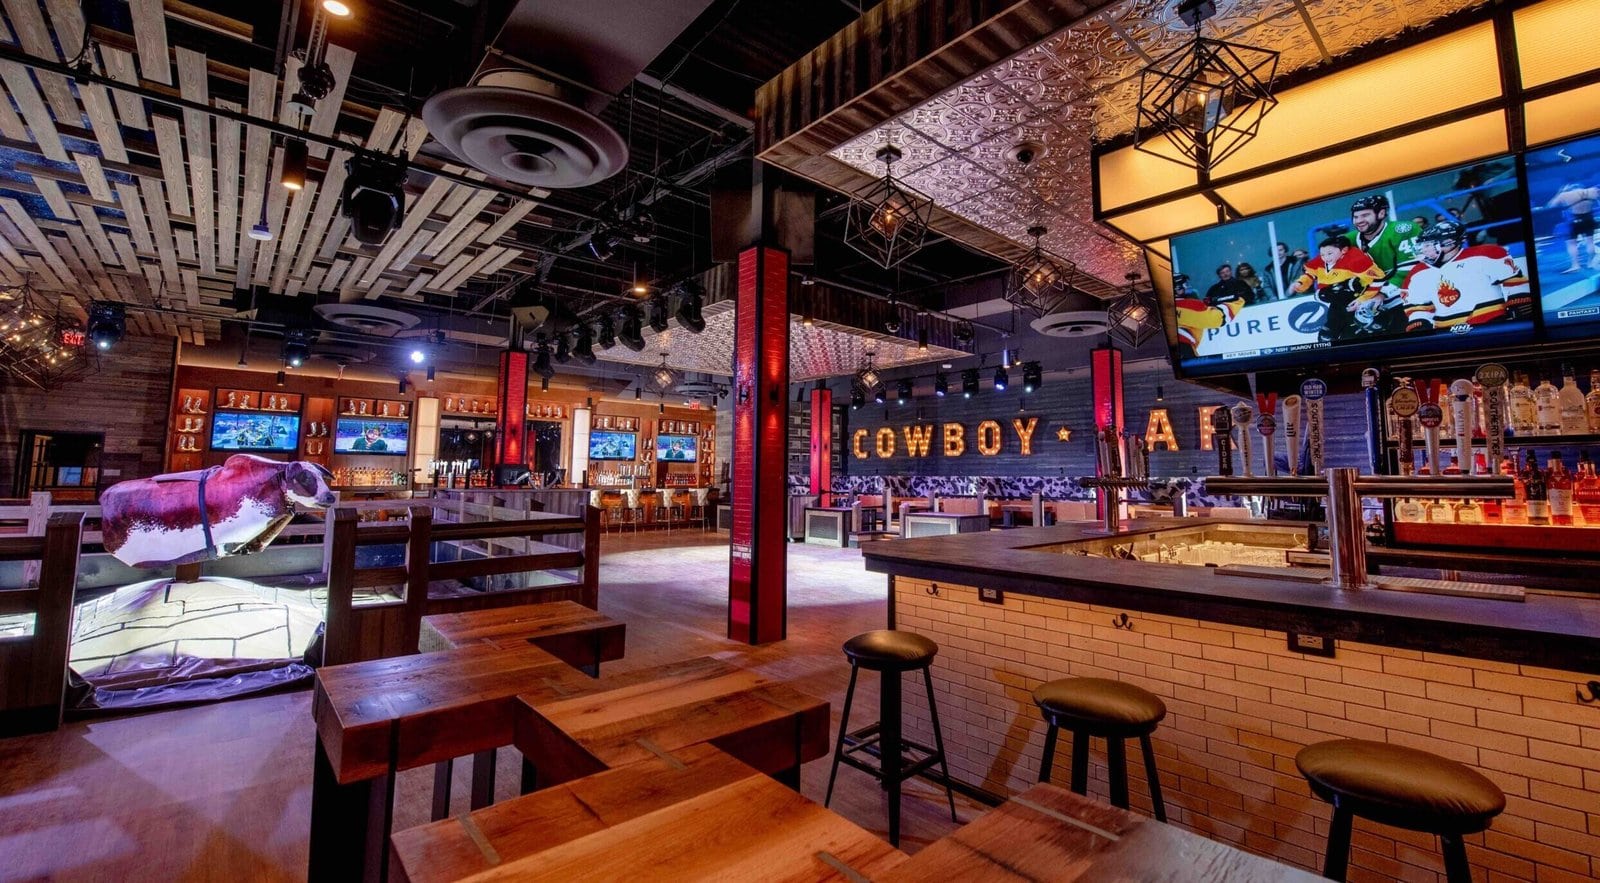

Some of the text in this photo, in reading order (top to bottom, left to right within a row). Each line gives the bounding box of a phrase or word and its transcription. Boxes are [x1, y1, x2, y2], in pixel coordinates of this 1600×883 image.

[63, 333, 83, 345] EXIT
[1208, 316, 1281, 341] PURE
[1450, 324, 1473, 333] NHL
[1311, 402, 1320, 443] SOUTHERN
[1489, 391, 1501, 456] SOUTHERN TIER
[853, 417, 1039, 459] COWBOY
[1220, 439, 1229, 469] CIDER
